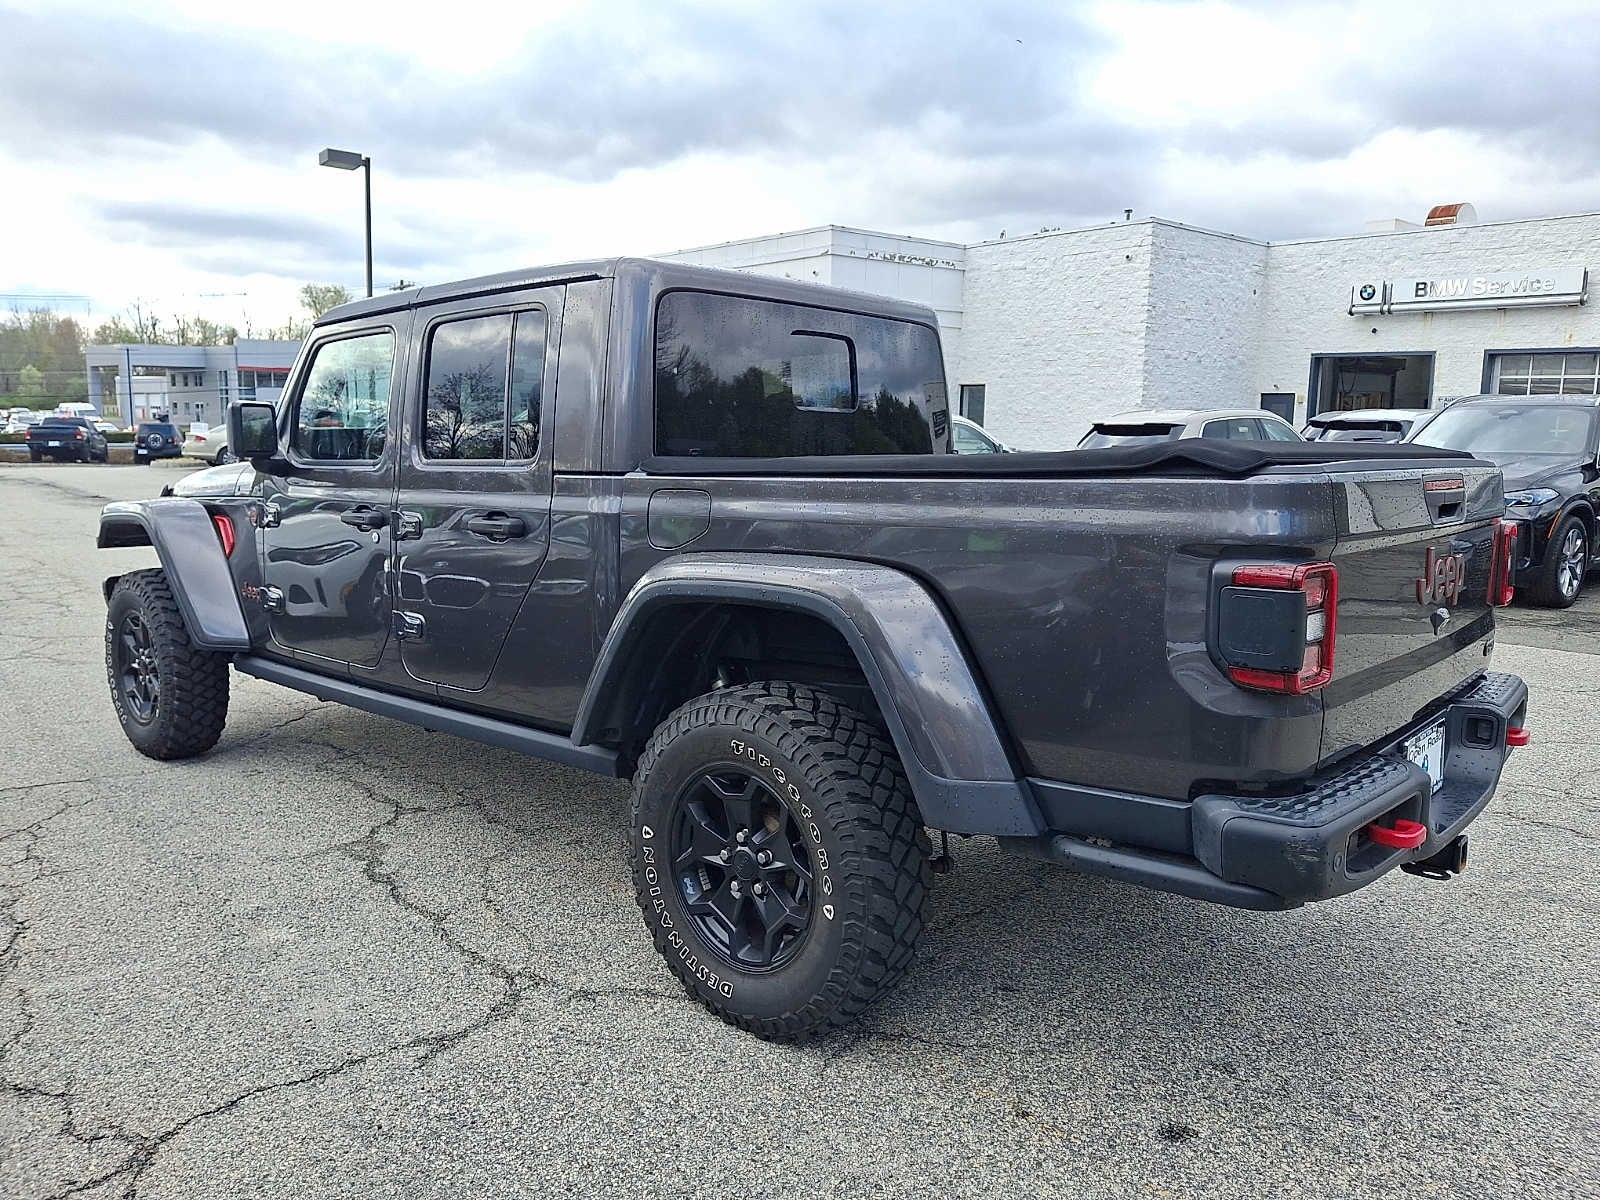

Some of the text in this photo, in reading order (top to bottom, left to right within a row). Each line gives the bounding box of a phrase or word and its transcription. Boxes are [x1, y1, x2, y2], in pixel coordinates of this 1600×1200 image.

[1414, 275, 1555, 298] BMW Service
[1416, 546, 1464, 606] Jeep
[731, 739, 833, 896] Firestone
[642, 846, 734, 998] DESTINATION
